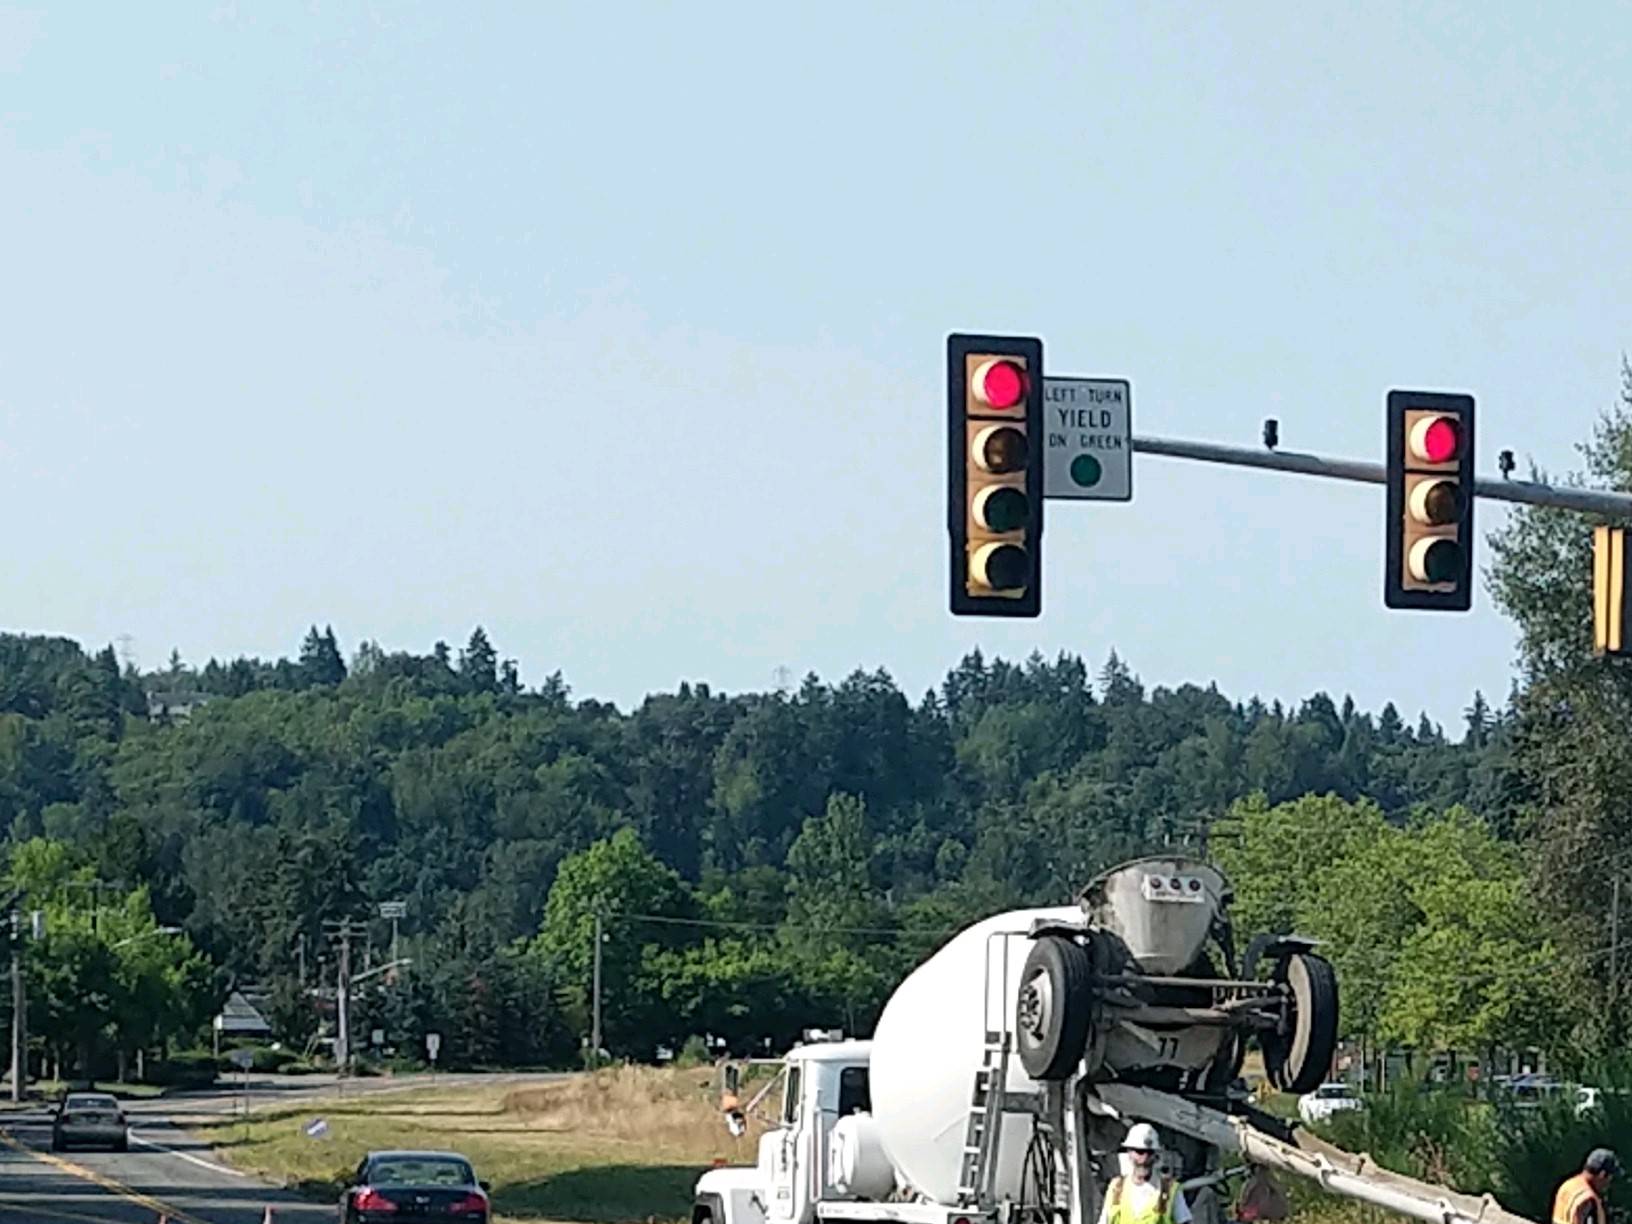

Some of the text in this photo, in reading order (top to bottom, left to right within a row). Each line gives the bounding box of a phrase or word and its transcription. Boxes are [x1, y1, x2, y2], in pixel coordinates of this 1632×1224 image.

[1045, 388, 1122, 404] LEFT TURN
[1058, 408, 1112, 428] YIELD
[1049, 432, 1122, 450] ON GREEN
[1158, 1037, 1179, 1060] 77
